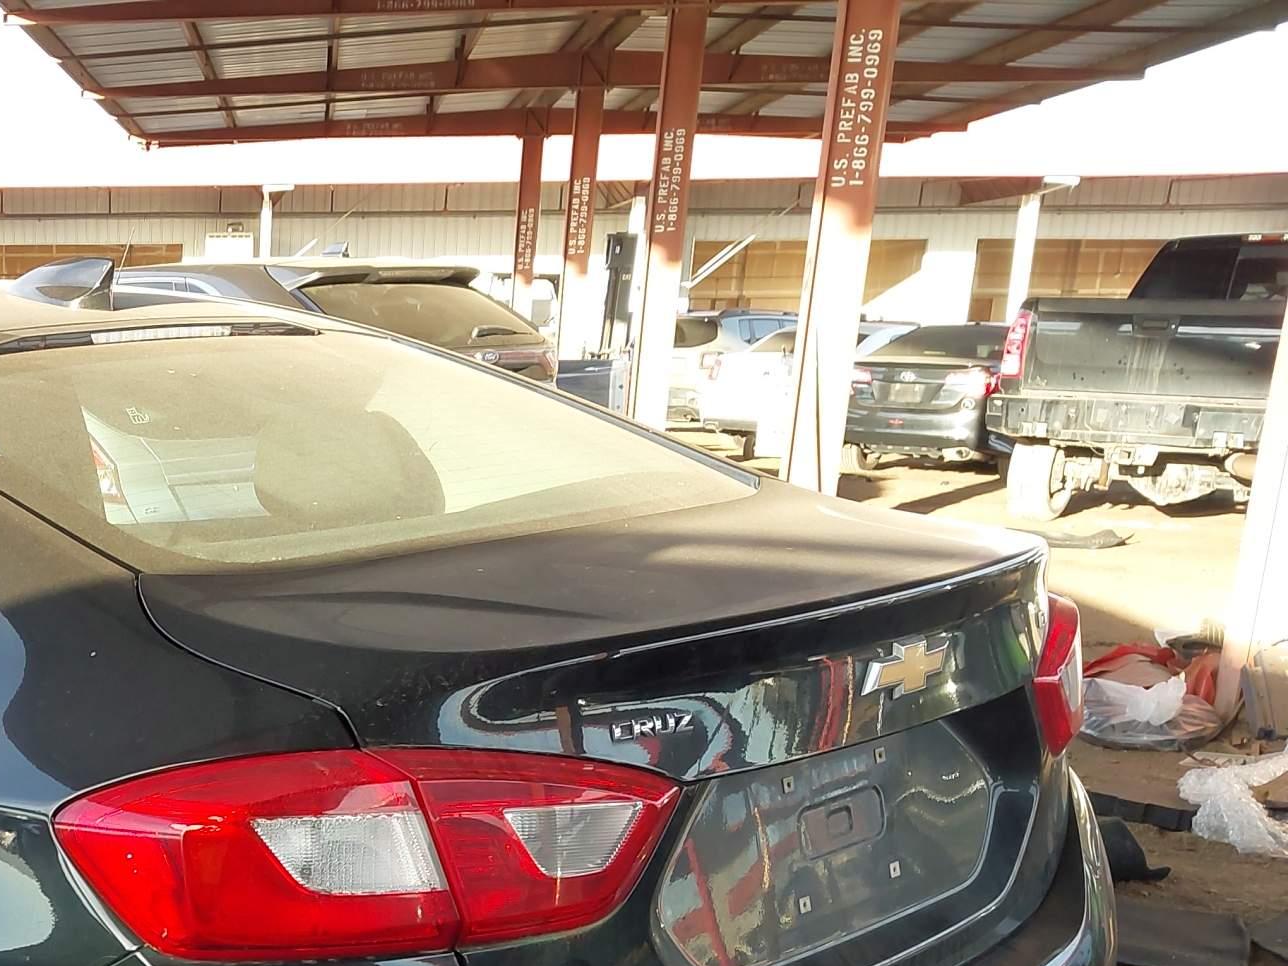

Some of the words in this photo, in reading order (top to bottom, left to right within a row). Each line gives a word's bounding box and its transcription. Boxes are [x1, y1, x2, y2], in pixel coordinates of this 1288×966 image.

[847, 28, 866, 64] INC.
[837, 72, 860, 143] PREFAB
[849, 28, 883, 187] 1-866-799-0969
[663, 128, 675, 152] INC.
[657, 157, 672, 204] PREFAB
[666, 128, 687, 232] 1-866-799-0969
[831, 153, 850, 188] U.S.
[569, 198, 581, 234] PREFAB
[654, 209, 667, 233] U.S.
[610, 711, 694, 741] CRUZ
